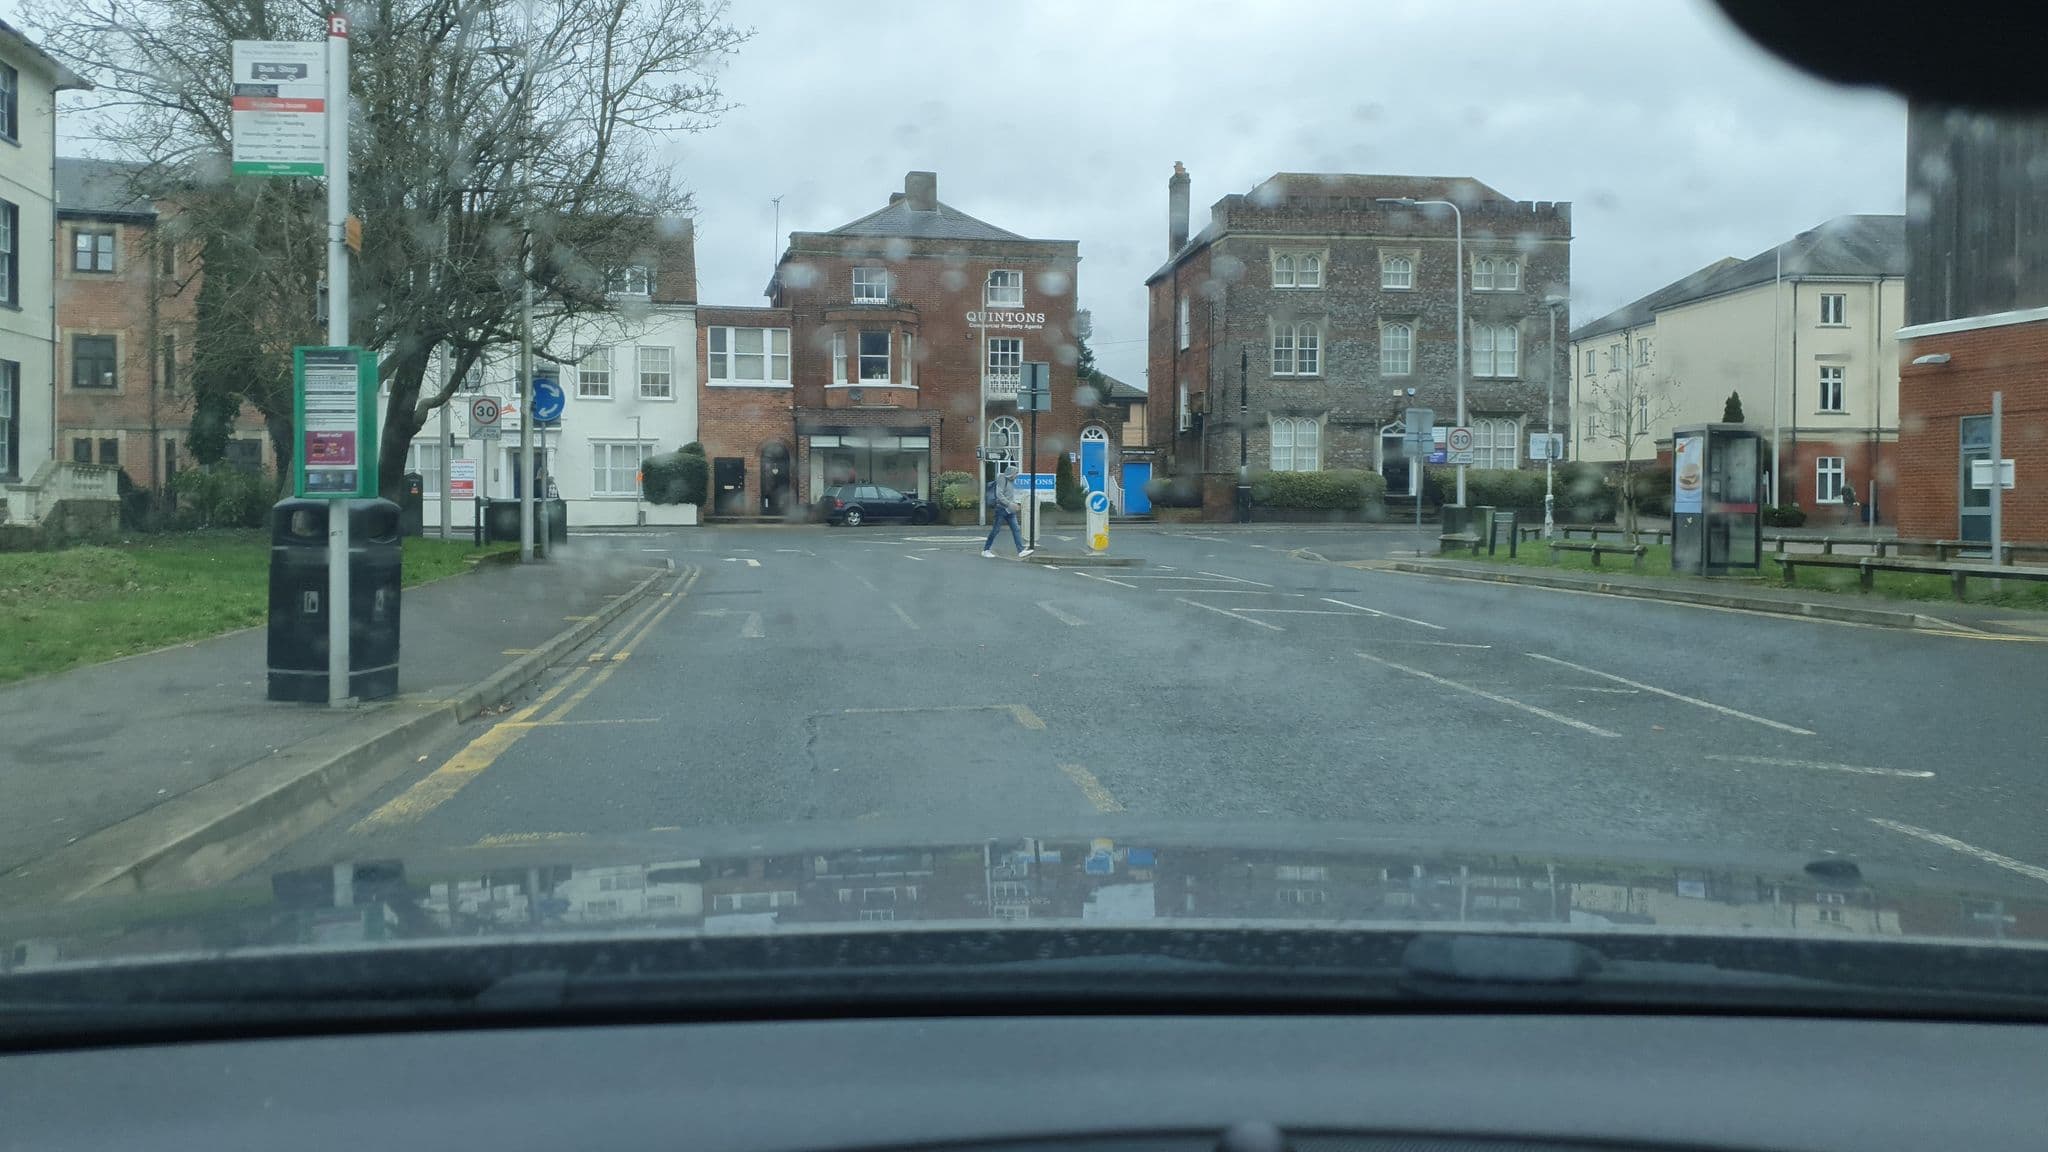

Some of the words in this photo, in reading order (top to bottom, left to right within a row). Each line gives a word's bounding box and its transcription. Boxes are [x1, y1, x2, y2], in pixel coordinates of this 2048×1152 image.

[332, 18, 346, 33] R
[258, 65, 275, 73] Bus
[279, 65, 298, 74] Stop
[966, 312, 1045, 323] QUINTONS
[476, 406, 495, 417] 30
[1453, 434, 1468, 445] 30
[1014, 478, 1053, 486] UINONS
